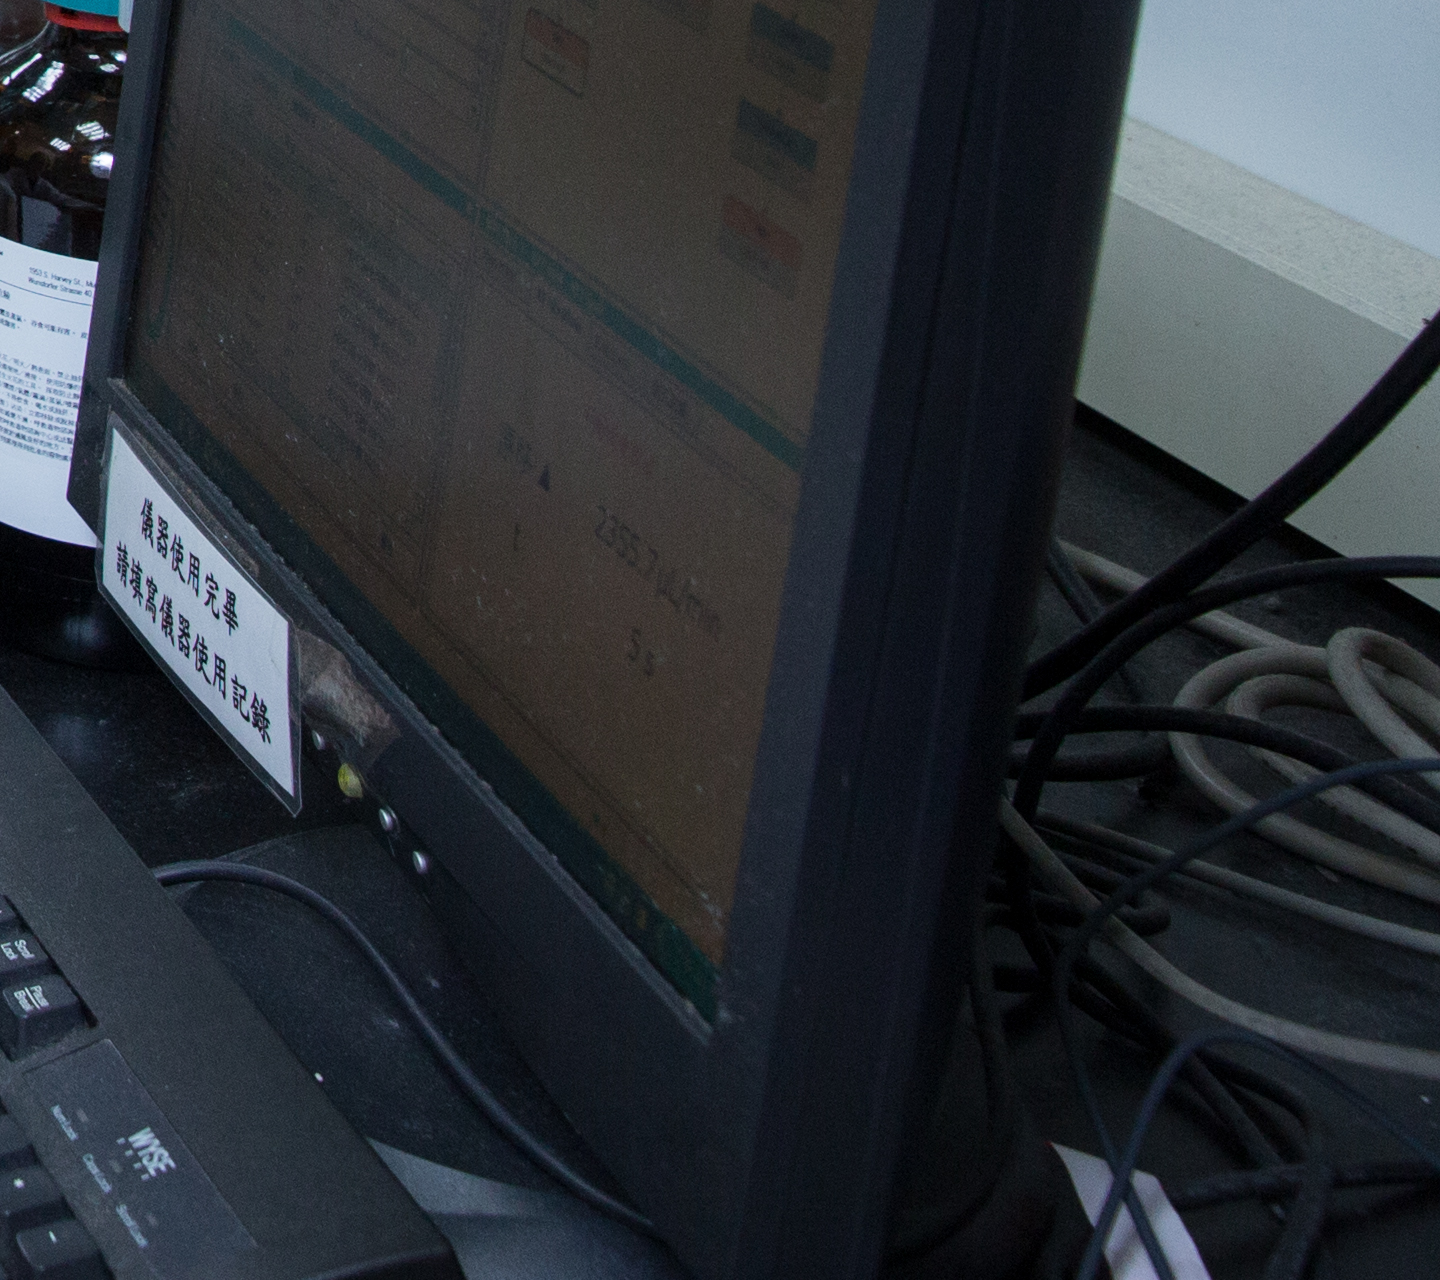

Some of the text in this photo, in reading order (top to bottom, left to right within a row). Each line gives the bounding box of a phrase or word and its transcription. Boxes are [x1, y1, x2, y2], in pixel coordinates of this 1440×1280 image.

[141, 497, 239, 637] 儀器使用完畢
[116, 540, 271, 744] 請填寫儀器使用記錄
[0, 942, 19, 961] Lock
[14, 939, 35, 958] Scroll
[13, 989, 33, 1013] Break
[30, 984, 50, 1007] Pause
[127, 1126, 177, 1178] WYSE
